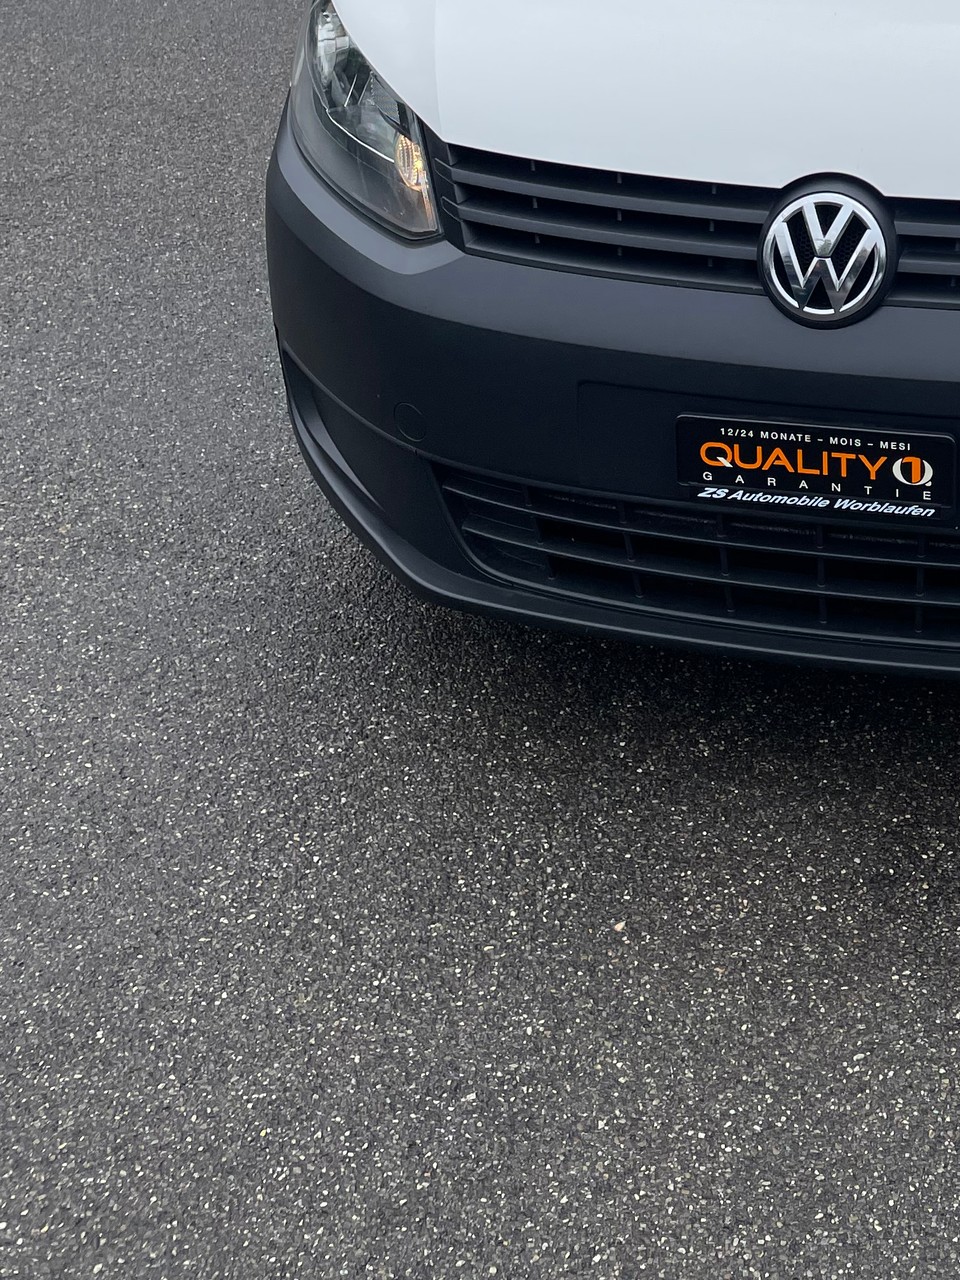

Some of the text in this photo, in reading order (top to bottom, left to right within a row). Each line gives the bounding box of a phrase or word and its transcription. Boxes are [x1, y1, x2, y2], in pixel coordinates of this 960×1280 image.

[768, 196, 881, 317] VW
[720, 427, 754, 438] 12/24
[760, 431, 812, 443] MONATE
[829, 437, 862, 448] MOIS
[880, 441, 911, 451] MESI
[699, 441, 888, 480] QUALITY
[702, 471, 932, 500] GARANTIE
[697, 486, 936, 518] ZS Automobile Worblaufen
